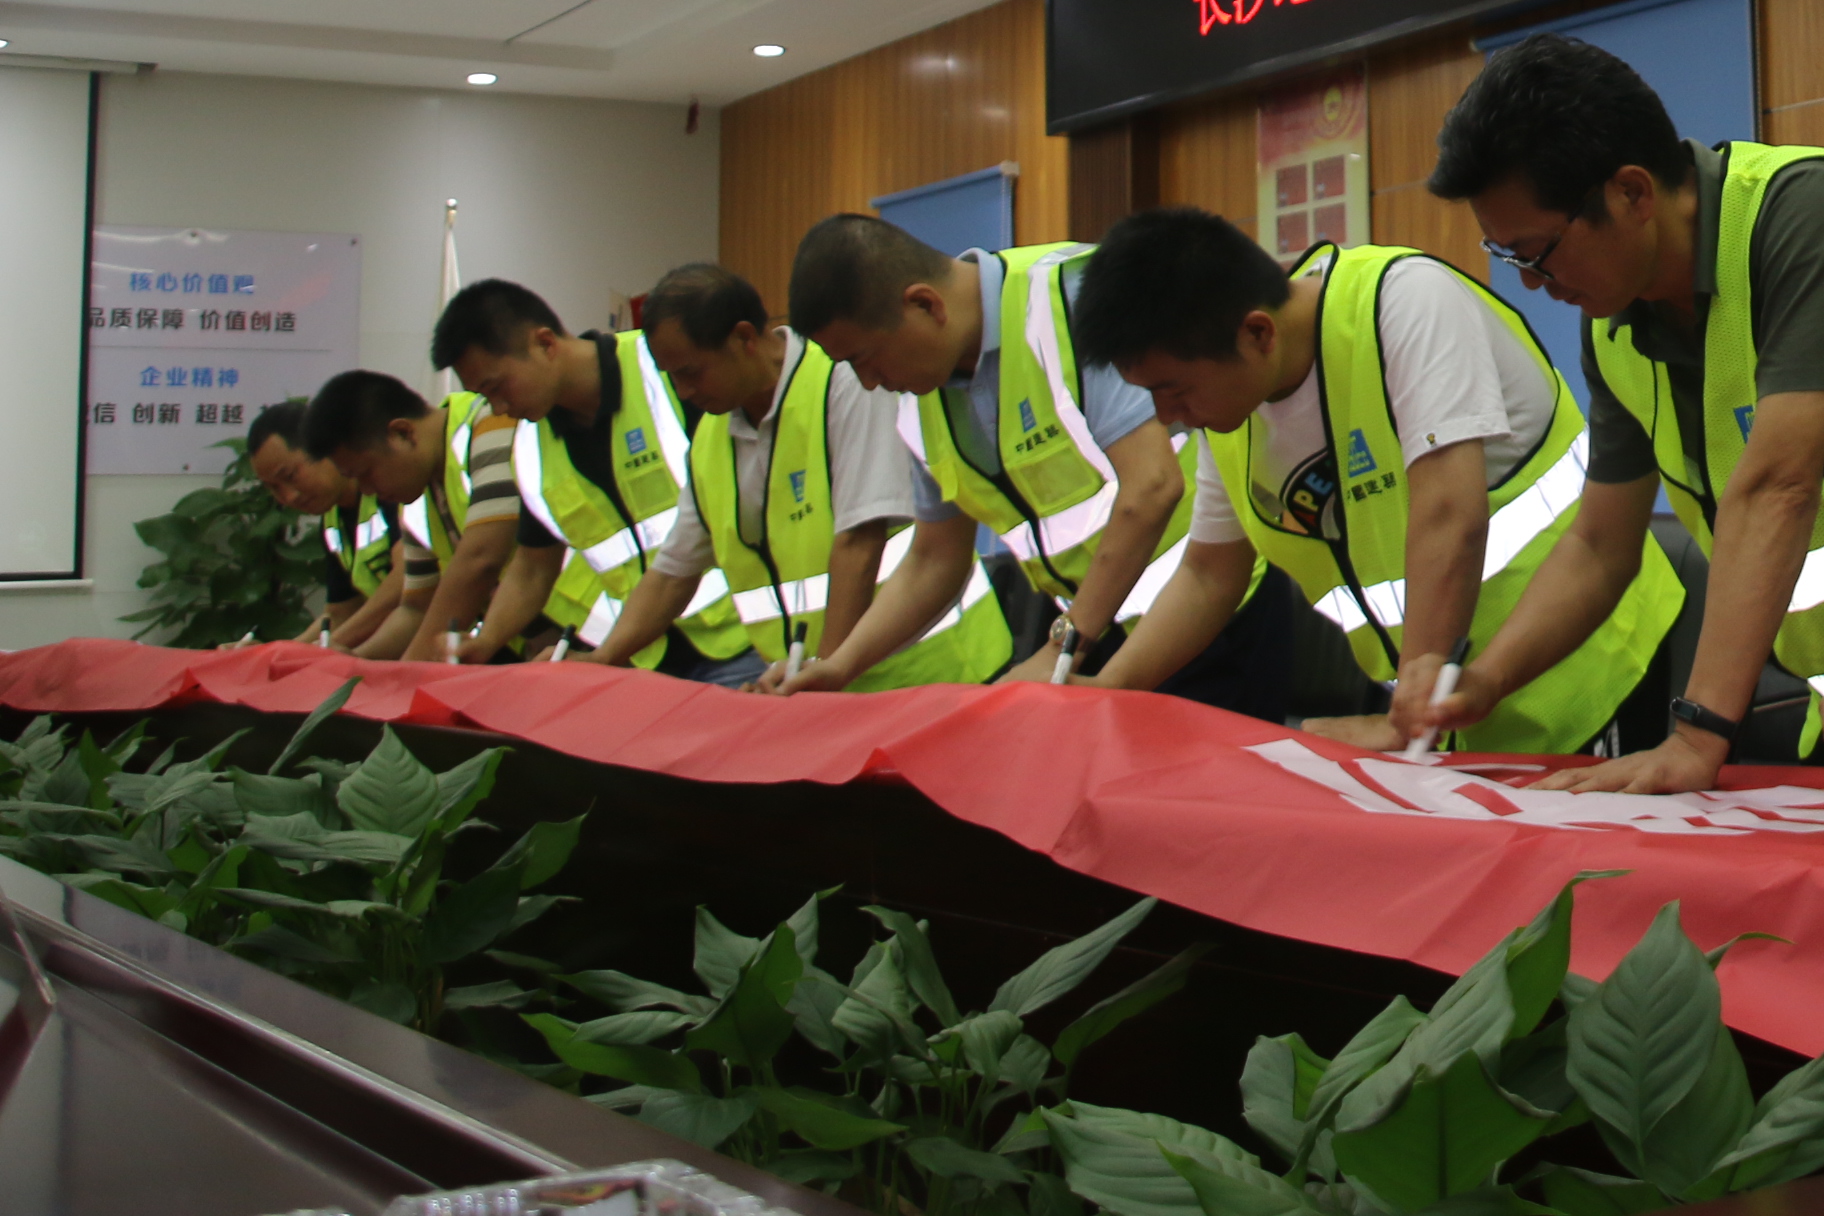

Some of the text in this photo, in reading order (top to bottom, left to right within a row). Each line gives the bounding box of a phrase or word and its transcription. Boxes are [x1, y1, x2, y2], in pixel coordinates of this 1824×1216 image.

[129, 272, 255, 295] 核心价值观
[89, 307, 297, 332] 品质保障 价值创造
[140, 366, 239, 388] 企业精神
[87, 402, 244, 424] 信 创新 超越
